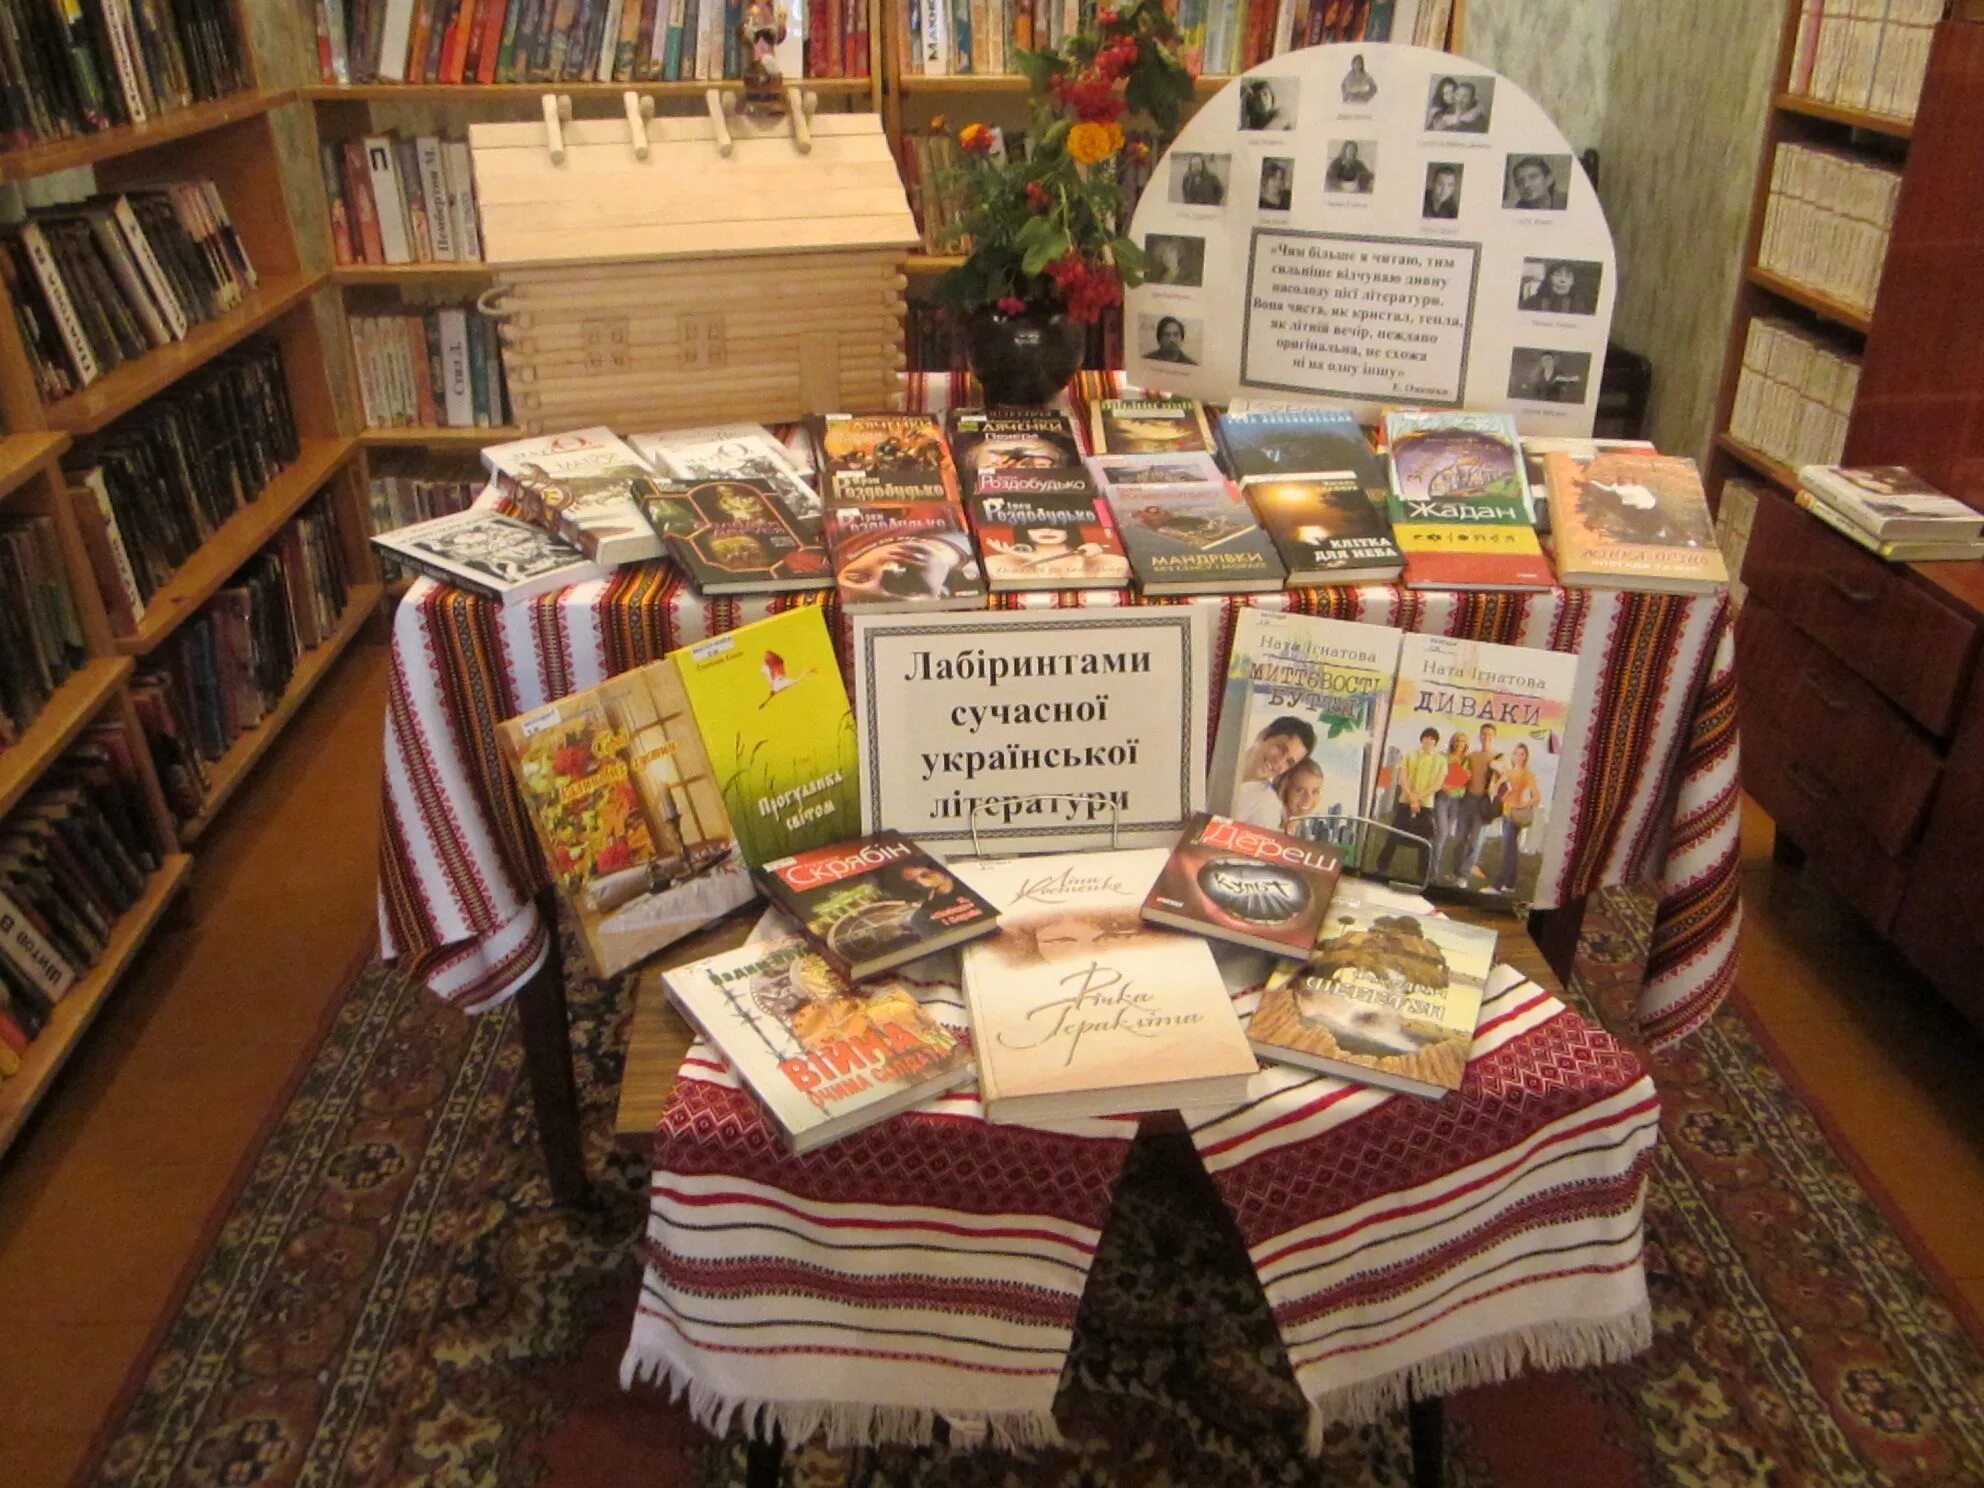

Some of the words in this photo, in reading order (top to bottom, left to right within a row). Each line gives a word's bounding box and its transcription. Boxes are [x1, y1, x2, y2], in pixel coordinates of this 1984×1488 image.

[370, 147, 388, 171] П
[1270, 243, 1305, 257] «Чим
[1308, 247, 1356, 263] більше
[1360, 252, 1368, 262] я
[1372, 253, 1422, 268] читаю,
[1427, 257, 1456, 268] тим
[1271, 263, 1333, 279] сильніше
[1336, 267, 1402, 284] відчуваю
[1405, 275, 1447, 290] дивну
[1272, 283, 1330, 300] насолоду
[1361, 291, 1445, 307] літератури.
[1253, 298, 1284, 312] Вона
[1332, 307, 1348, 318] як
[1352, 308, 1414, 325] кристал,
[1270, 320, 1286, 331] як
[1290, 320, 1329, 334] літній
[1333, 324, 1373, 341] вечір,
[1276, 337, 1361, 356] оригінальна,
[1365, 347, 1382, 358] не
[1385, 349, 1428, 361] схожа
[1292, 356, 1305, 368] ні
[1308, 360, 1324, 371] на
[1328, 363, 1358, 375] одну
[981, 475, 1085, 491] Роздобудько
[983, 497, 1096, 524] Роздобудько
[1407, 501, 1517, 520] Жадан
[1314, 549, 1349, 562] ДЛЯ
[1328, 537, 1393, 549] КЛІТКА
[1151, 552, 1264, 566] МАНДРІВКИ
[1260, 634, 1301, 651] Ната
[1306, 640, 1377, 663] Ігнатова
[904, 649, 1152, 687] Лабіринтами
[1249, 661, 1381, 695] МИТТЄВОСТІ
[1422, 659, 1464, 678] Ната
[1472, 665, 1547, 689] Ігнатова
[951, 694, 1109, 734] сучасної
[1414, 690, 1541, 727] ДИВАКИ
[921, 739, 1140, 781] української
[758, 770, 843, 822] Прогулянка
[930, 790, 1130, 824] літератури
[786, 799, 836, 832] світом
[1201, 823, 1338, 871] Дереш
[784, 842, 912, 886] Скрябін
[1008, 877, 1135, 907] Костенко
[1032, 866, 1101, 893] Ліна
[1060, 961, 1163, 1012] Ріка
[997, 1004, 1204, 1068] Геракліта
[806, 1074, 874, 1109] ОЧИМА
